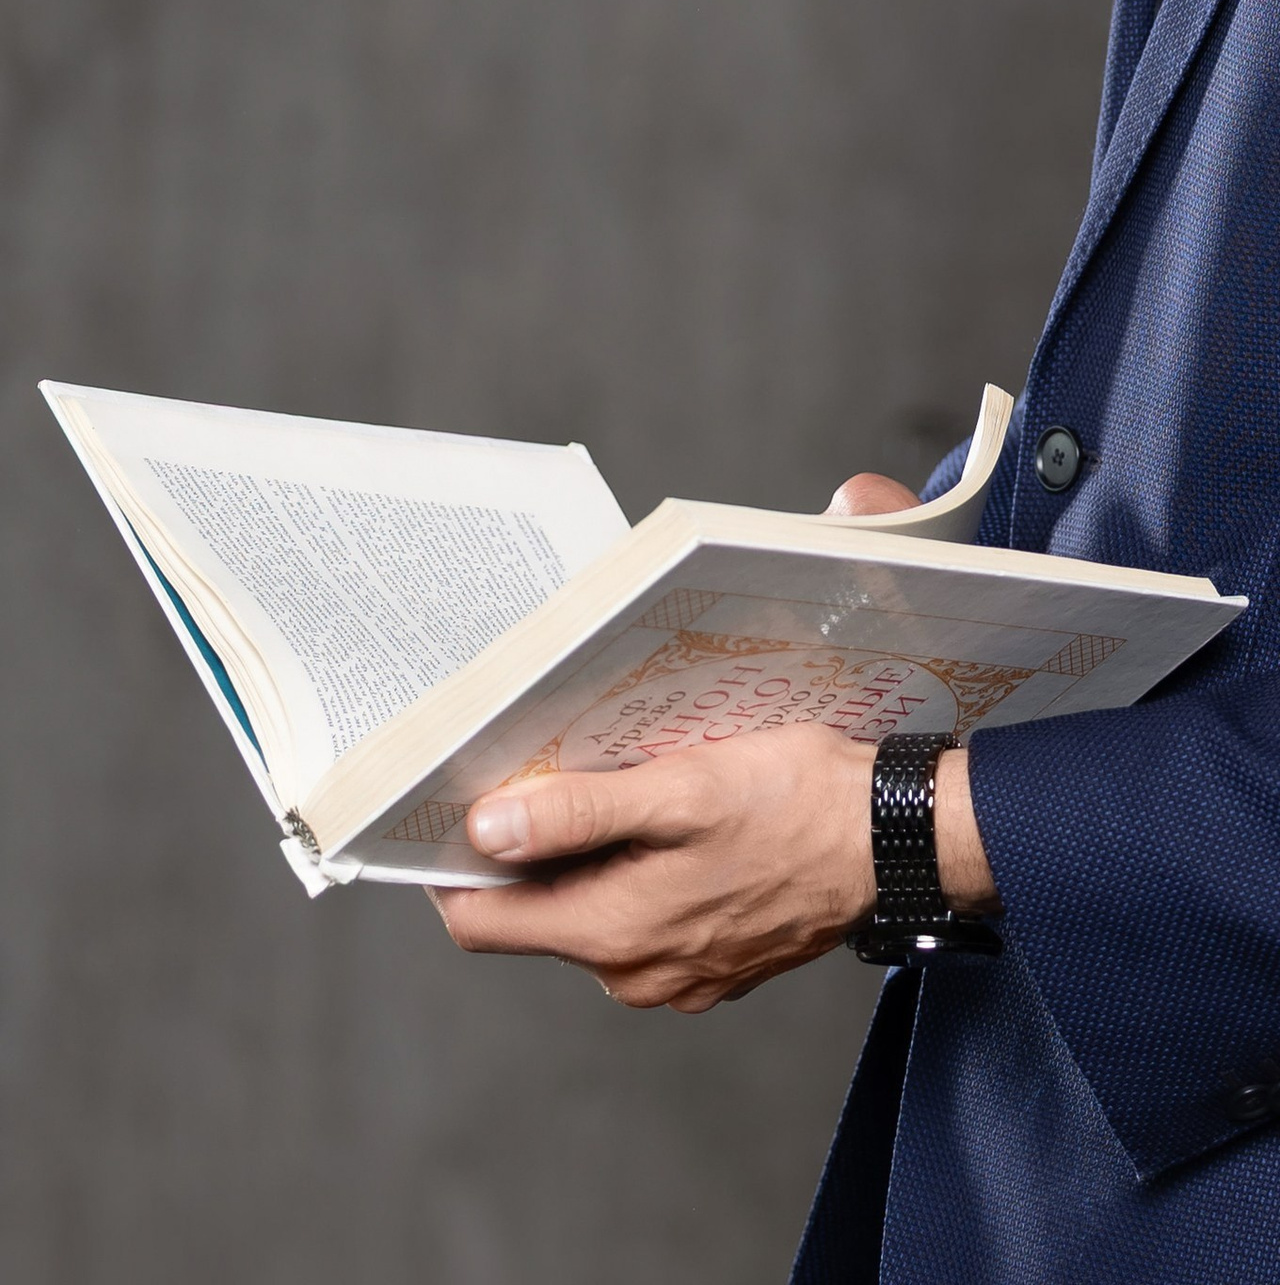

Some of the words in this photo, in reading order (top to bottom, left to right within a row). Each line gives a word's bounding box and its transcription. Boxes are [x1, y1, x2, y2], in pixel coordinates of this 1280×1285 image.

[600, 691, 687, 758] ПРЕВО
[688, 677, 791, 748] СКО
[821, 666, 916, 732] НЫЕ
